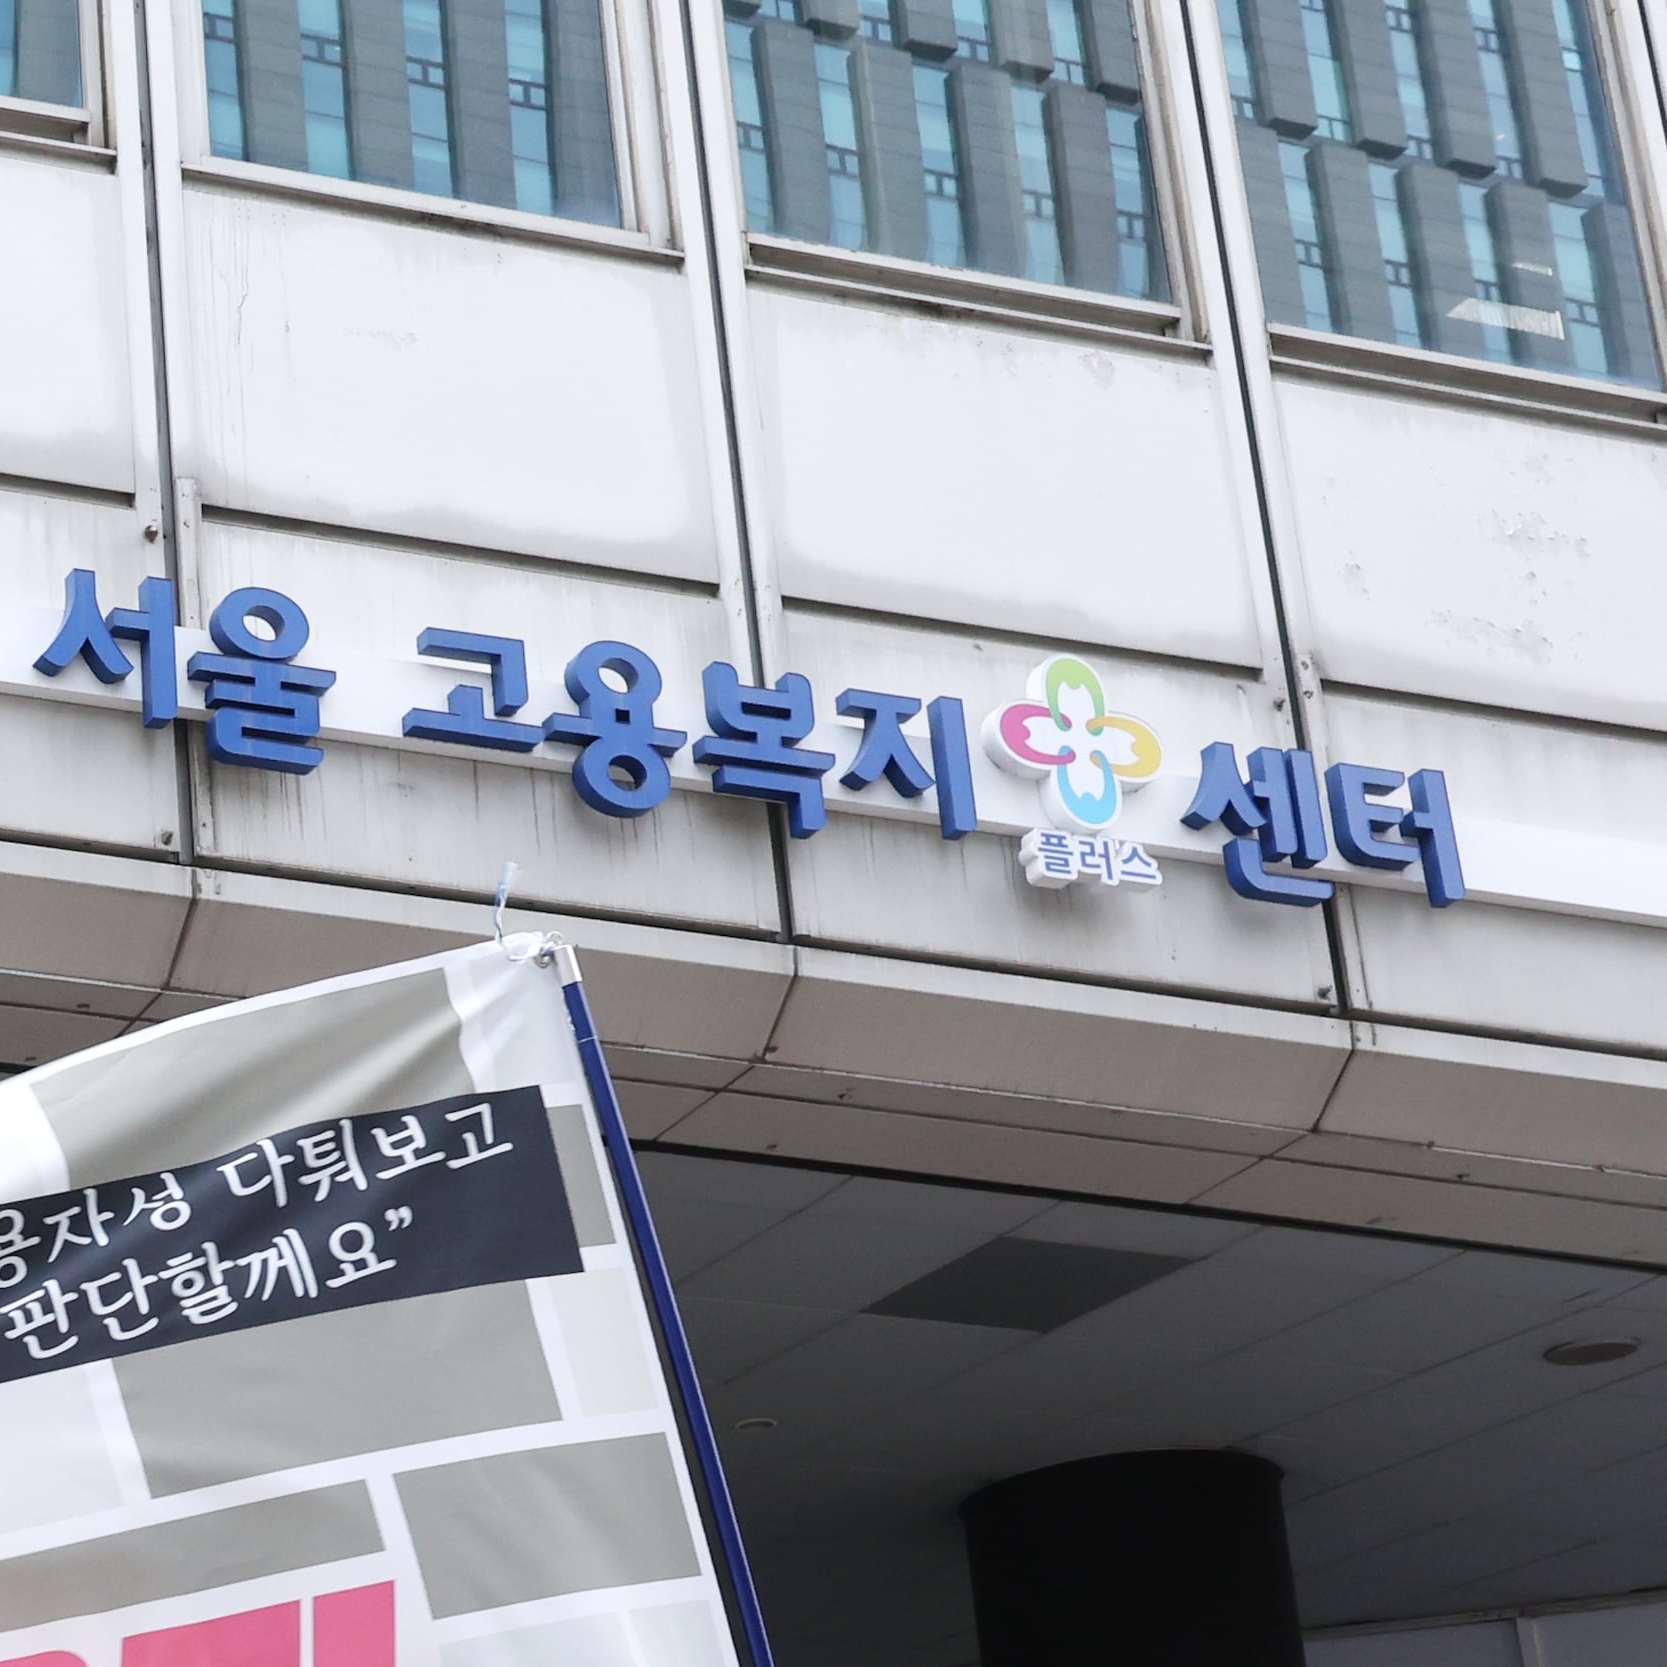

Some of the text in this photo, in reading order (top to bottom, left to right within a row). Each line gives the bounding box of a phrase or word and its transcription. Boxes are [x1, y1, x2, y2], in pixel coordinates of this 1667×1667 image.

[33, 568, 1466, 910] 서울 고용복지 플러스 센터
[216, 1101, 515, 1208] 다퉈보고
